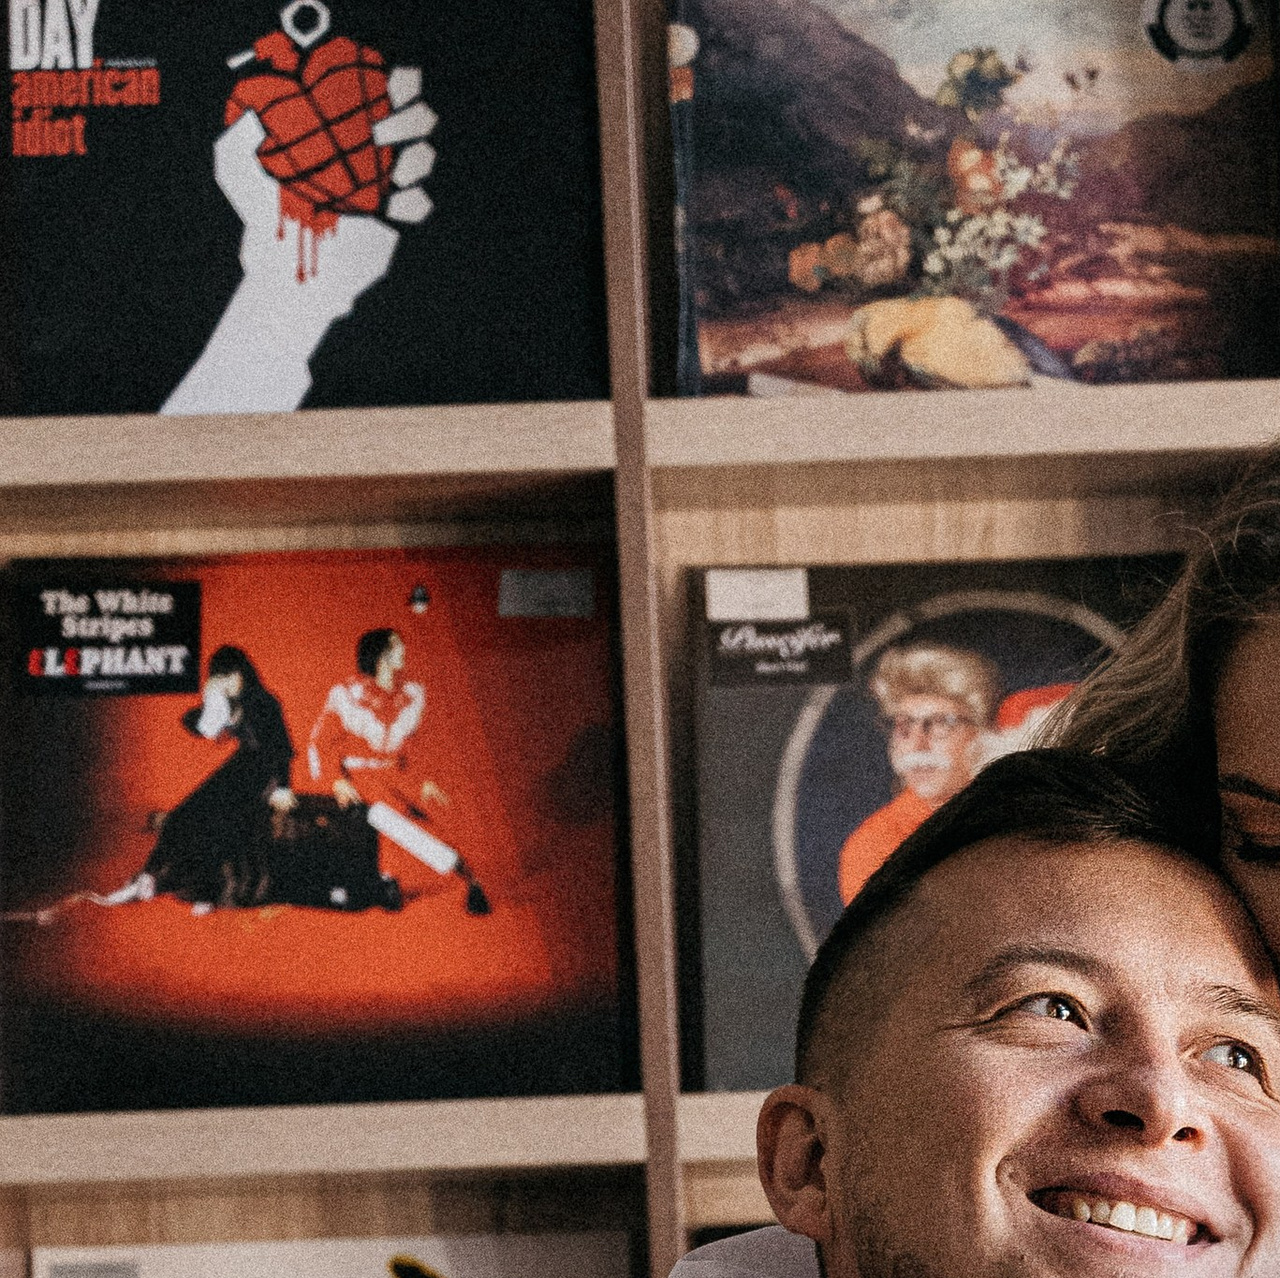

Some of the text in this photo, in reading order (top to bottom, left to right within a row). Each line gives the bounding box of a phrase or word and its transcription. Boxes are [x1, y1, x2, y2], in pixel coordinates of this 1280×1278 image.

[8, 0, 99, 70] DAY
[11, 59, 160, 106] american
[12, 108, 87, 156] idiot
[41, 588, 174, 615] The White
[61, 615, 154, 643] Stripes
[27, 646, 189, 677] ELEPHANT
